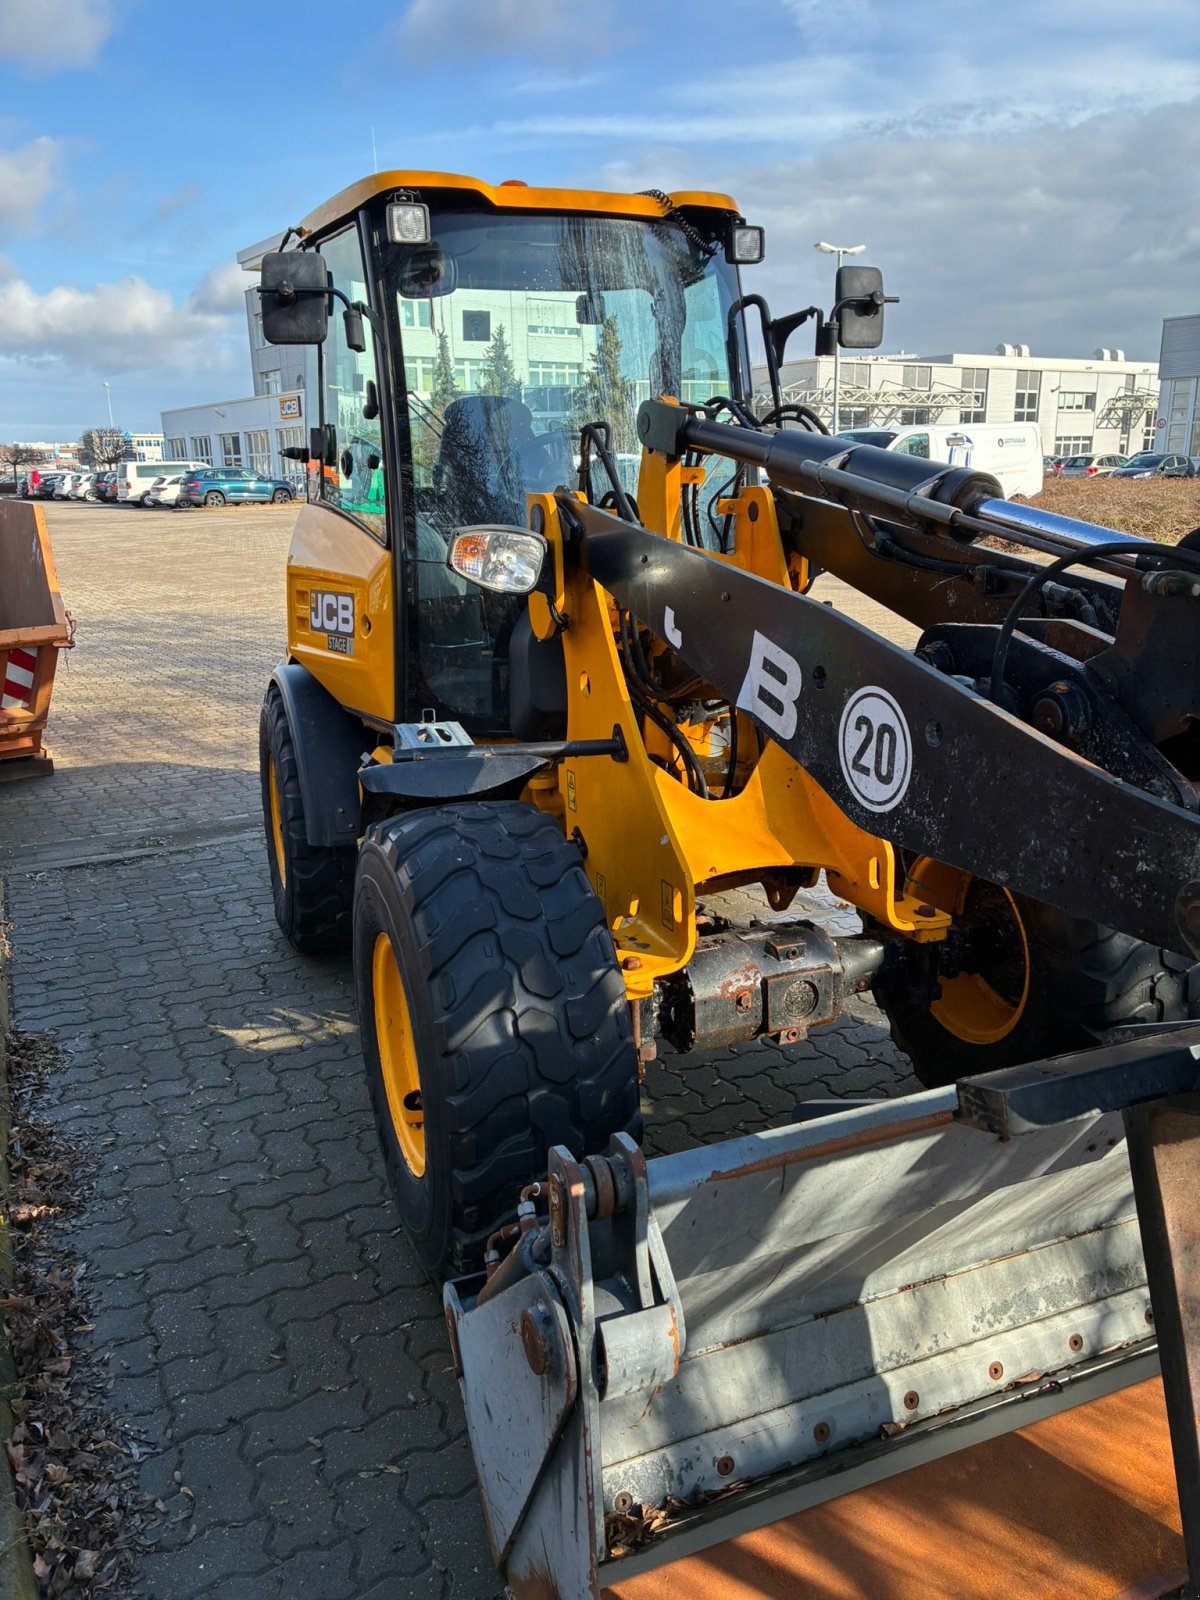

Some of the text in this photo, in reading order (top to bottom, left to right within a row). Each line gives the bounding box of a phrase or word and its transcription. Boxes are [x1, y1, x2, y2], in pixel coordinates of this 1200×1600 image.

[281, 400, 297, 415] JCB
[311, 593, 354, 633] JCB
[328, 636, 347, 652] STAGE
[852, 715, 897, 785] 20
